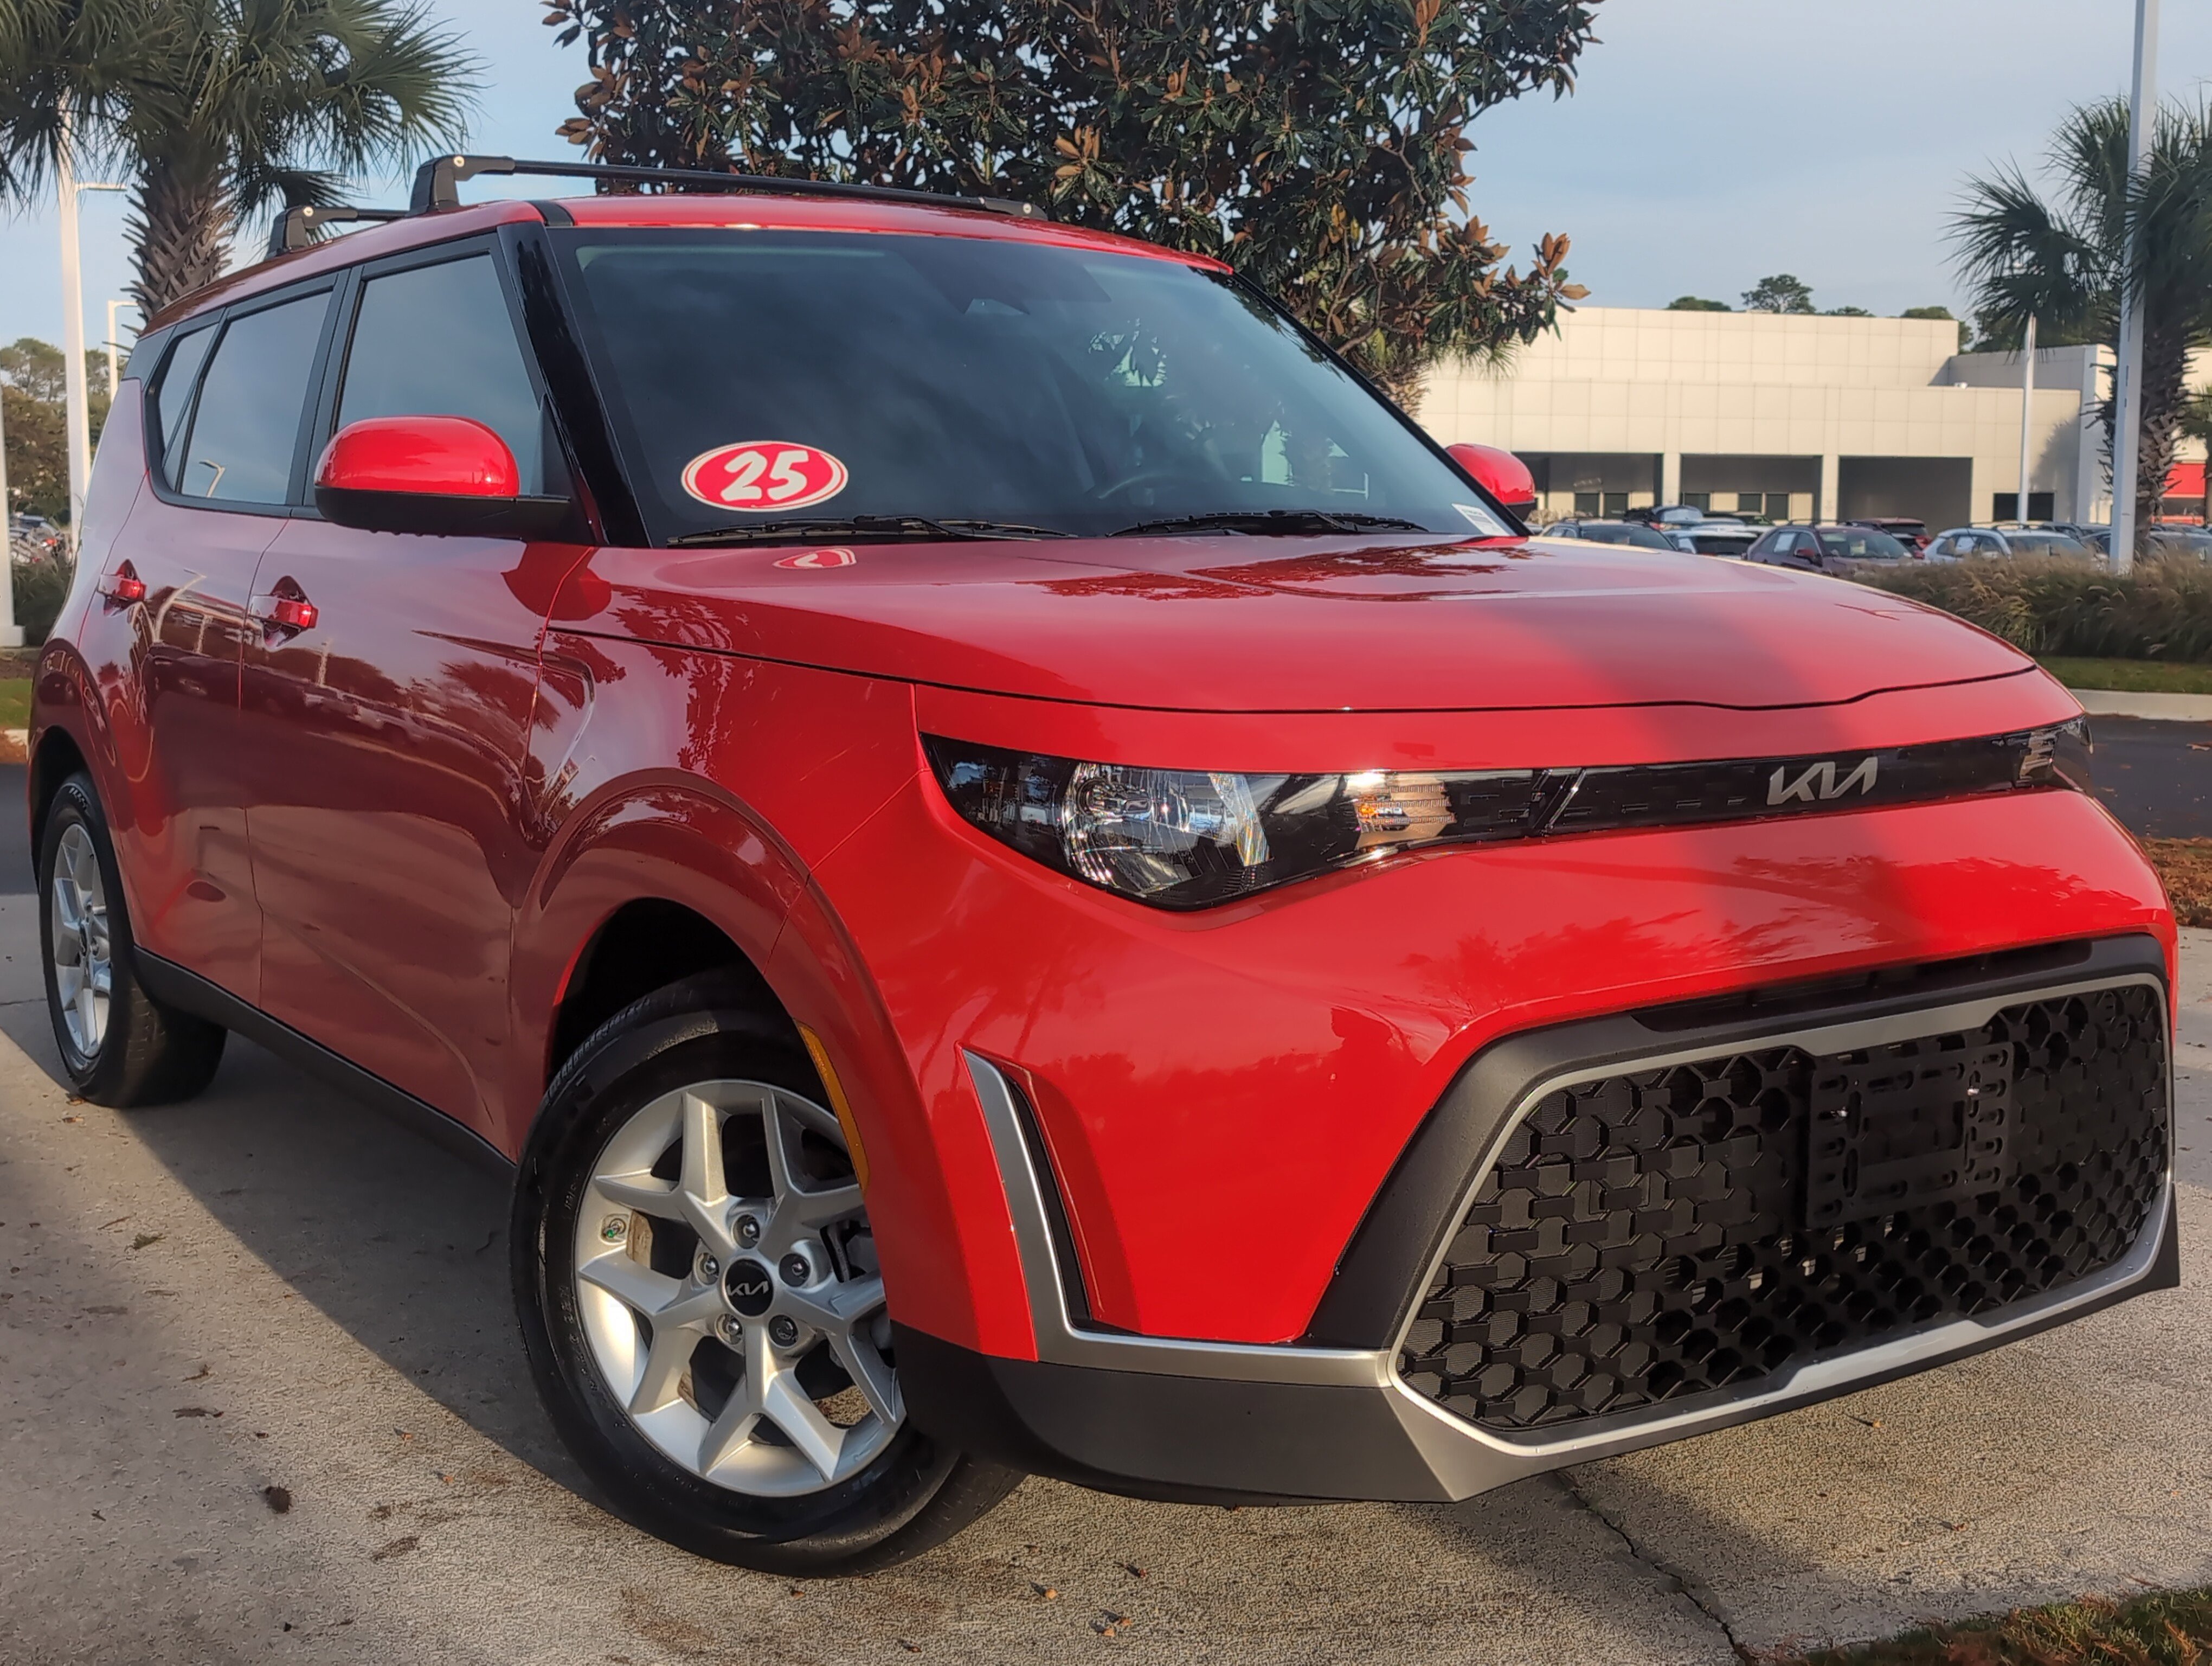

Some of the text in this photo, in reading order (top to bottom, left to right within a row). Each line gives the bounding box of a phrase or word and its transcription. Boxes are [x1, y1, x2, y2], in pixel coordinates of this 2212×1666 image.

[720, 450, 809, 501] 25
[1766, 756, 1879, 805] KIA
[726, 1280, 769, 1296] KIA
